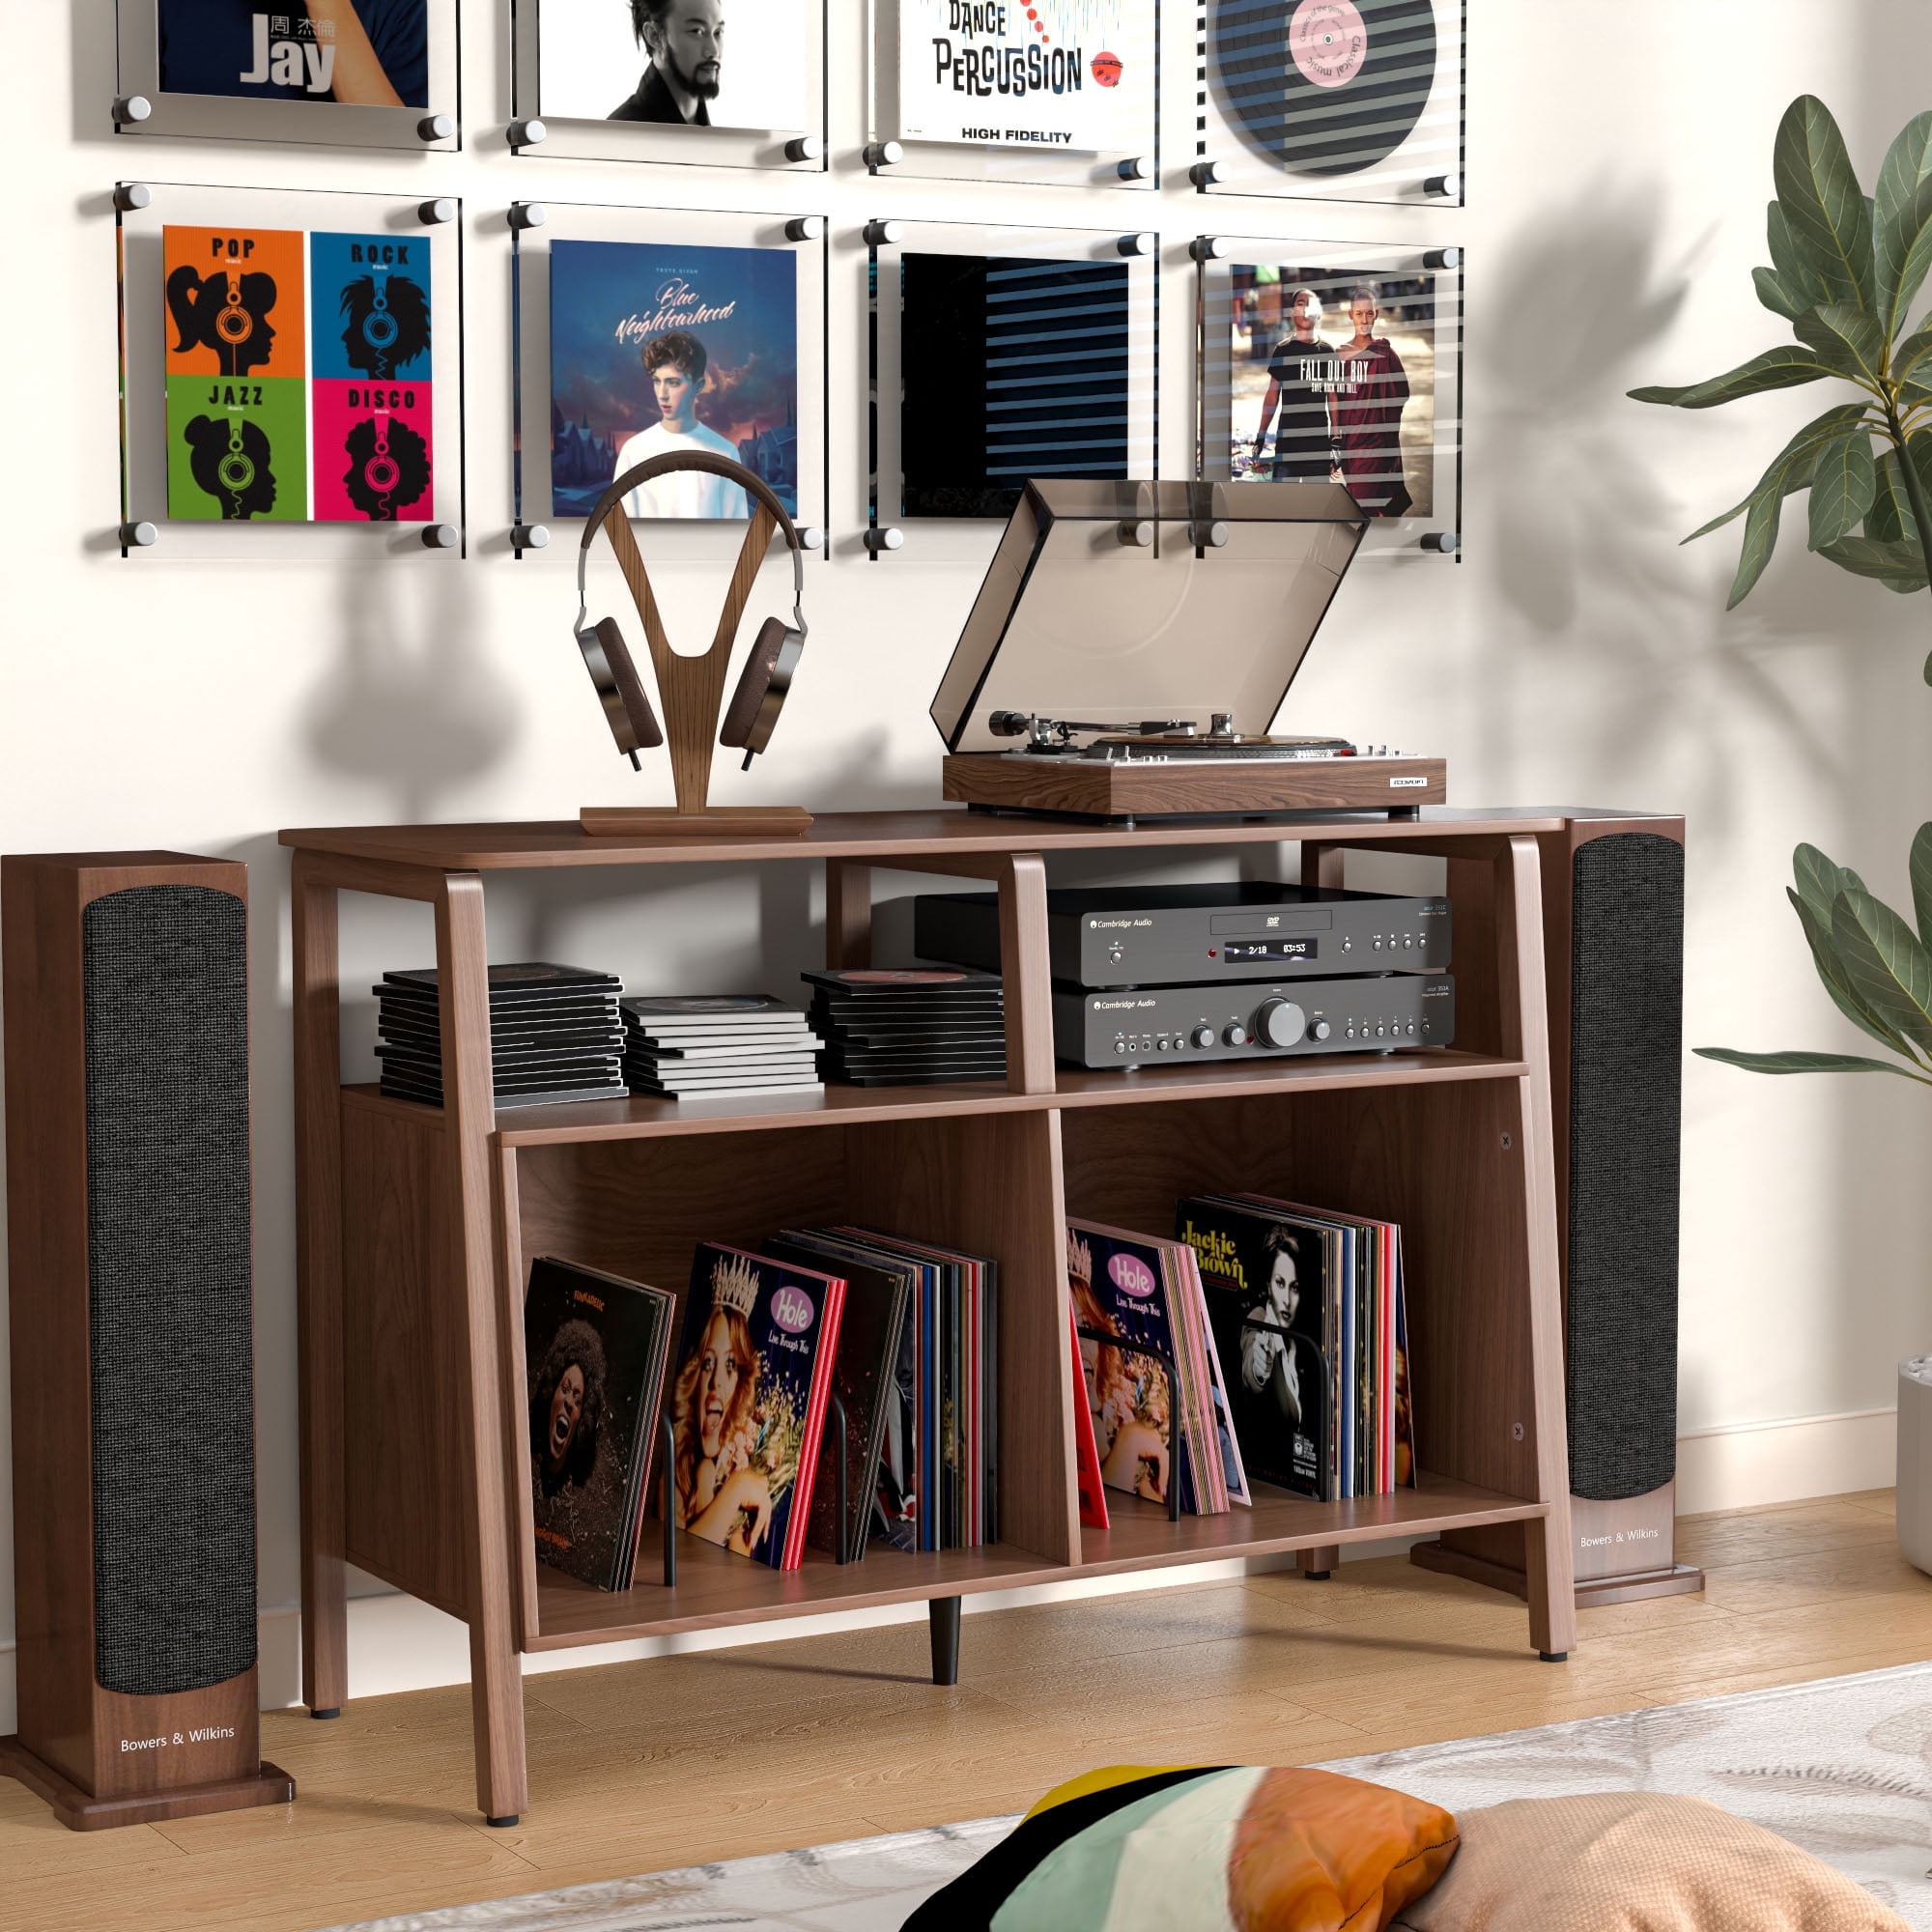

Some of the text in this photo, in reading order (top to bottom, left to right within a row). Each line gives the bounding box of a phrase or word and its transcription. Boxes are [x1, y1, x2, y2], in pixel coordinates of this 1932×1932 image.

[949, 0, 1007, 40] DANCE
[240, 13, 336, 94] Jay
[1306, 56, 1332, 76] music
[1336, 35, 1361, 77] Classical
[932, 38, 1082, 98] PERCUSSION
[962, 128, 1072, 144] HIGH FIDELITY
[212, 238, 255, 258] POP
[351, 243, 410, 265] ROCK
[655, 277, 700, 310] Blue
[614, 300, 736, 345] Neighbourhood
[1300, 358, 1369, 383] FALL OUT BOY
[209, 385, 263, 406] JAZZ
[348, 388, 415, 409] DISCO
[1097, 919, 1152, 928] Cambridge Audio
[1248, 946, 1267, 954] 2/18
[1101, 999, 1156, 1009] Cambridge Audio
[1181, 1220, 1236, 1257] Jackie
[1115, 1256, 1151, 1293] Hole
[1195, 1247, 1248, 1290] Brown
[776, 1290, 809, 1328] Hole
[1116, 1293, 1160, 1317] Live Through This
[768, 1329, 810, 1354] Live Through This
[1580, 1529, 1659, 1548] Bowers & Wilkins
[121, 1726, 235, 1752] Bowers & Wilkins
